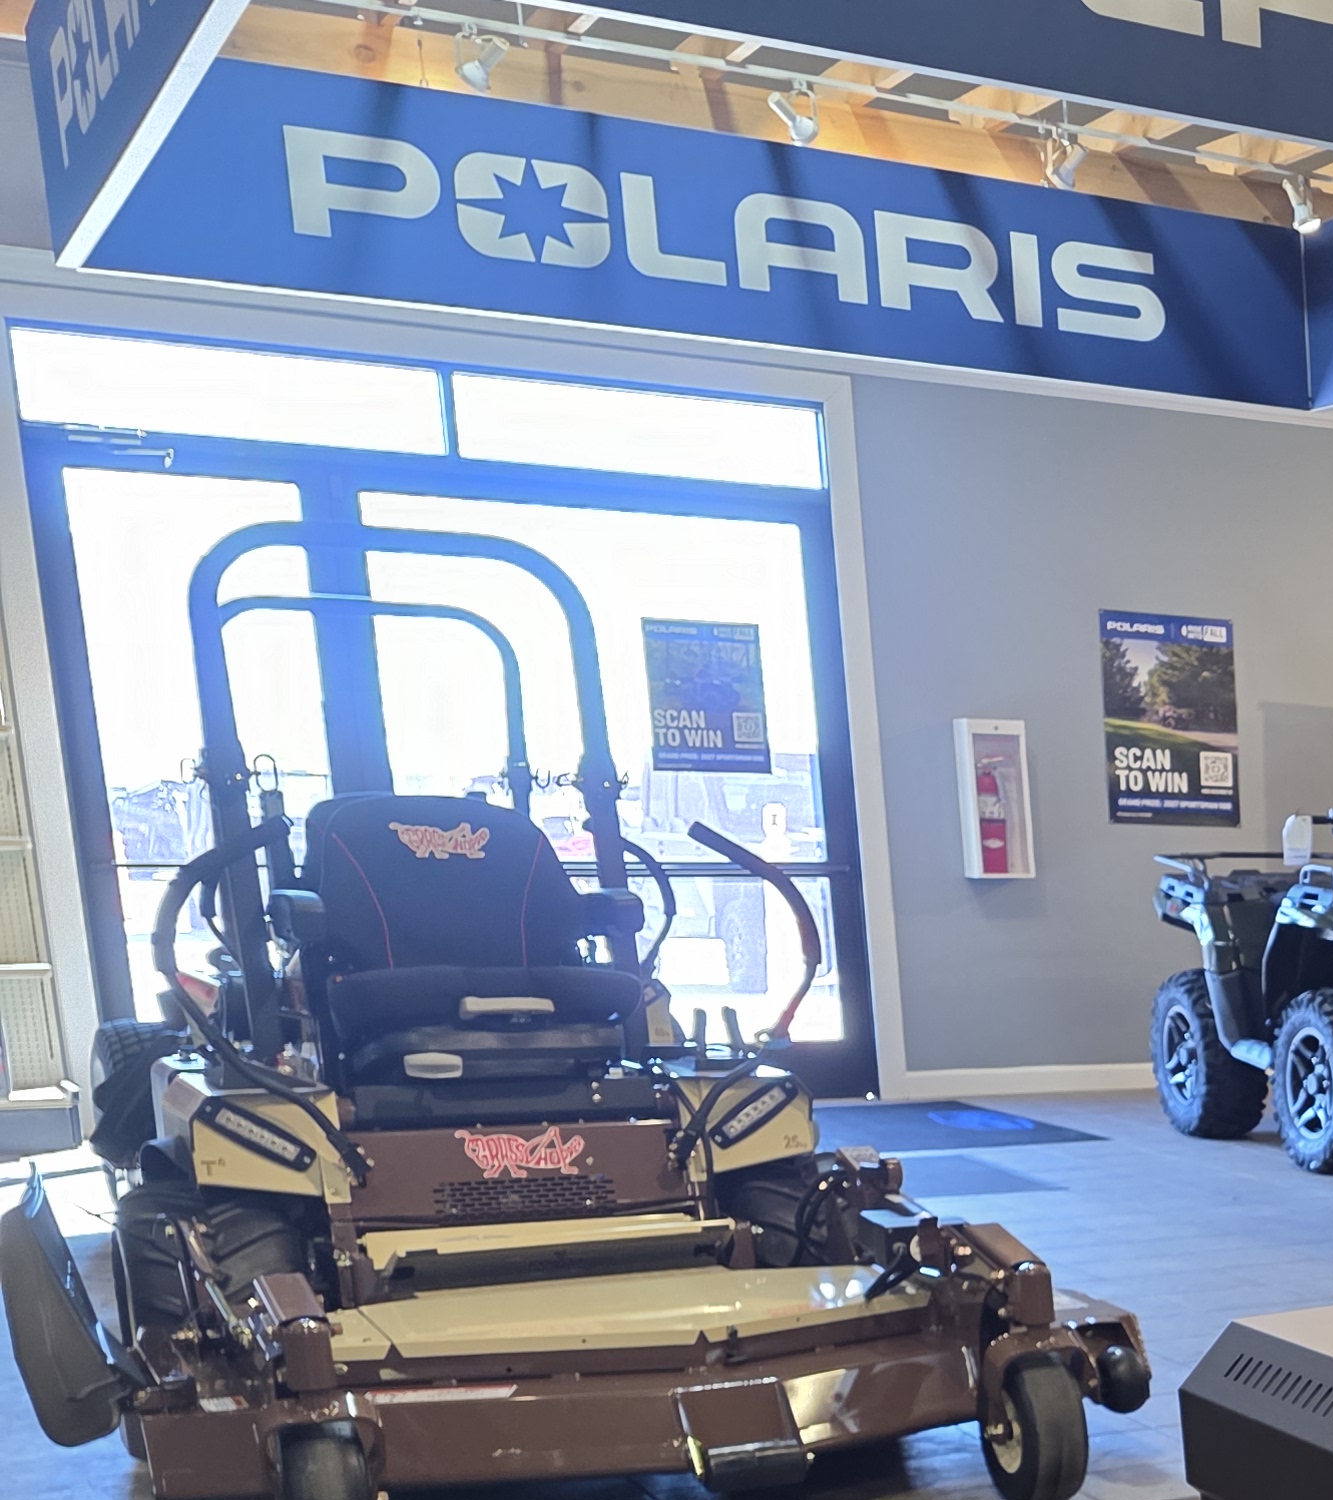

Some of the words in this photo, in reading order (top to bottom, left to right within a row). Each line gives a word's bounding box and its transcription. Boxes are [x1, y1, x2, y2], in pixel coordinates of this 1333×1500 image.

[283, 125, 1166, 341] POLARIS
[1106, 621, 1165, 634] POLARIS
[654, 709, 706, 728] SCAN
[655, 729, 681, 747] TO
[684, 730, 723, 748] WIN
[1114, 746, 1171, 770] SCAN
[1115, 769, 1143, 792] TO
[1147, 771, 1188, 794] WIN
